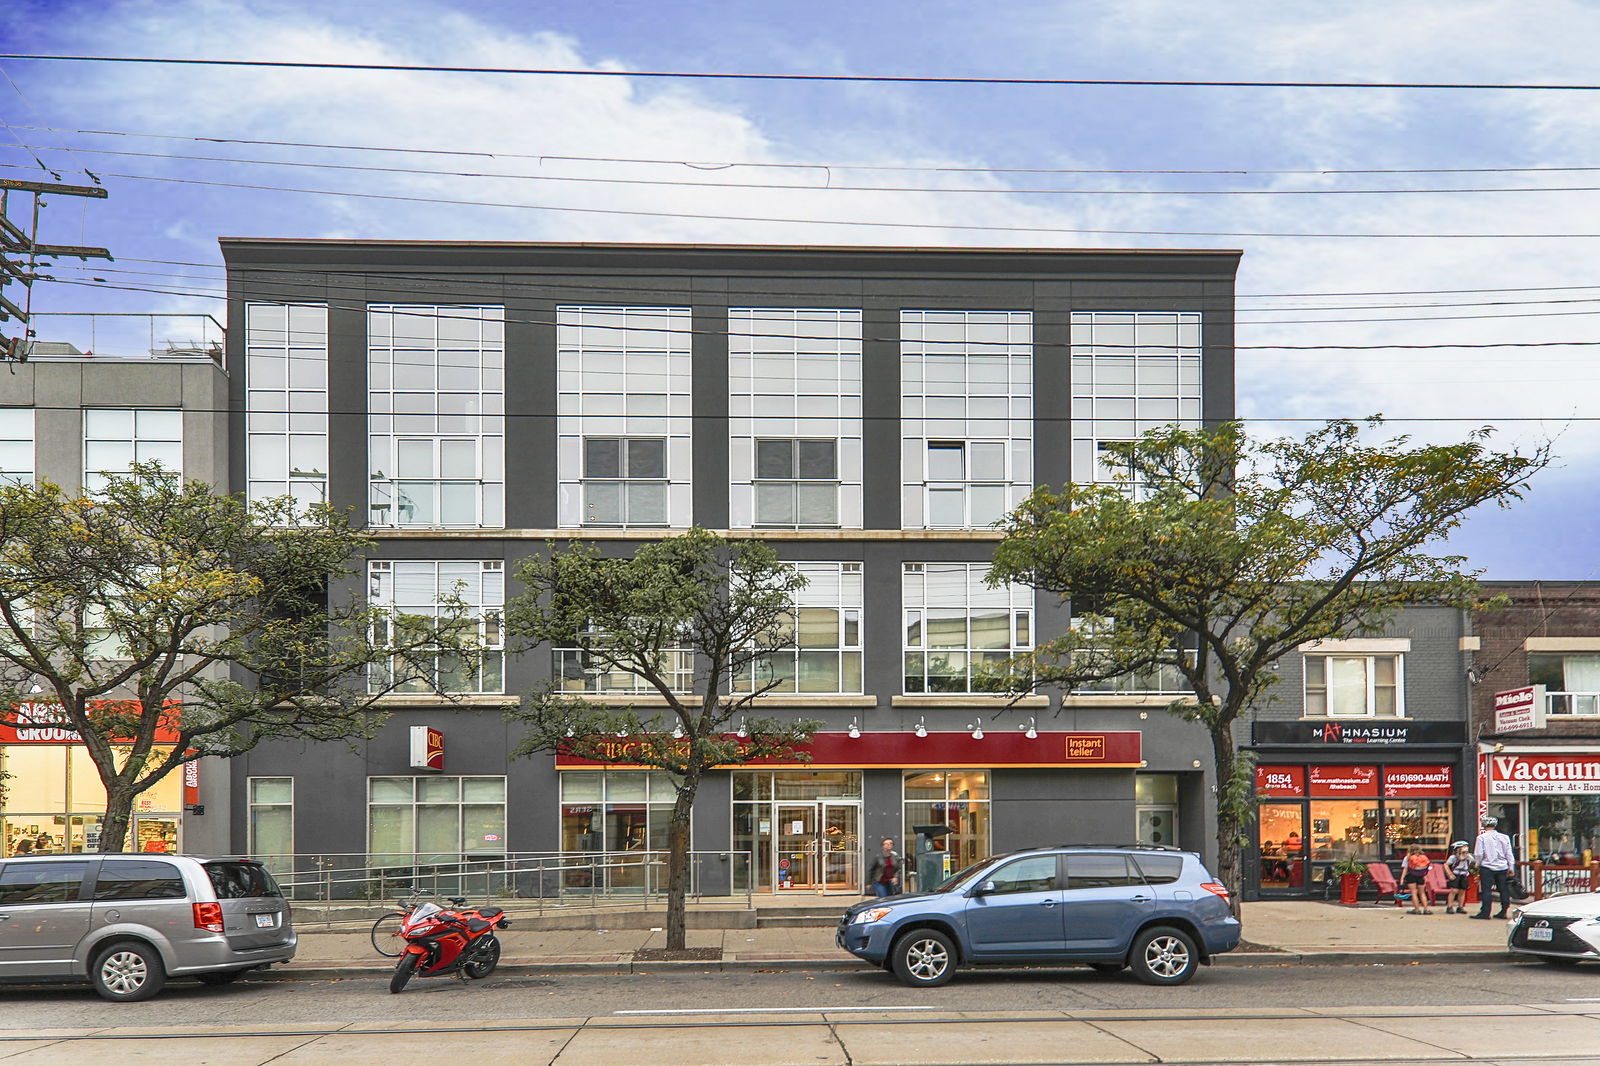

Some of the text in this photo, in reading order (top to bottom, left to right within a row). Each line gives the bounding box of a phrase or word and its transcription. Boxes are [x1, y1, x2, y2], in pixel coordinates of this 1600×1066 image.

[1496, 691, 1533, 706] Miele
[428, 731, 445, 749] CIBC
[1069, 747, 1094, 756] teller
[1266, 773, 1292, 784] 1854
[1387, 773, 1449, 783] (416)690-MATH
[1495, 783, 1517, 792] Sales
[1528, 783, 1555, 793] Repair
